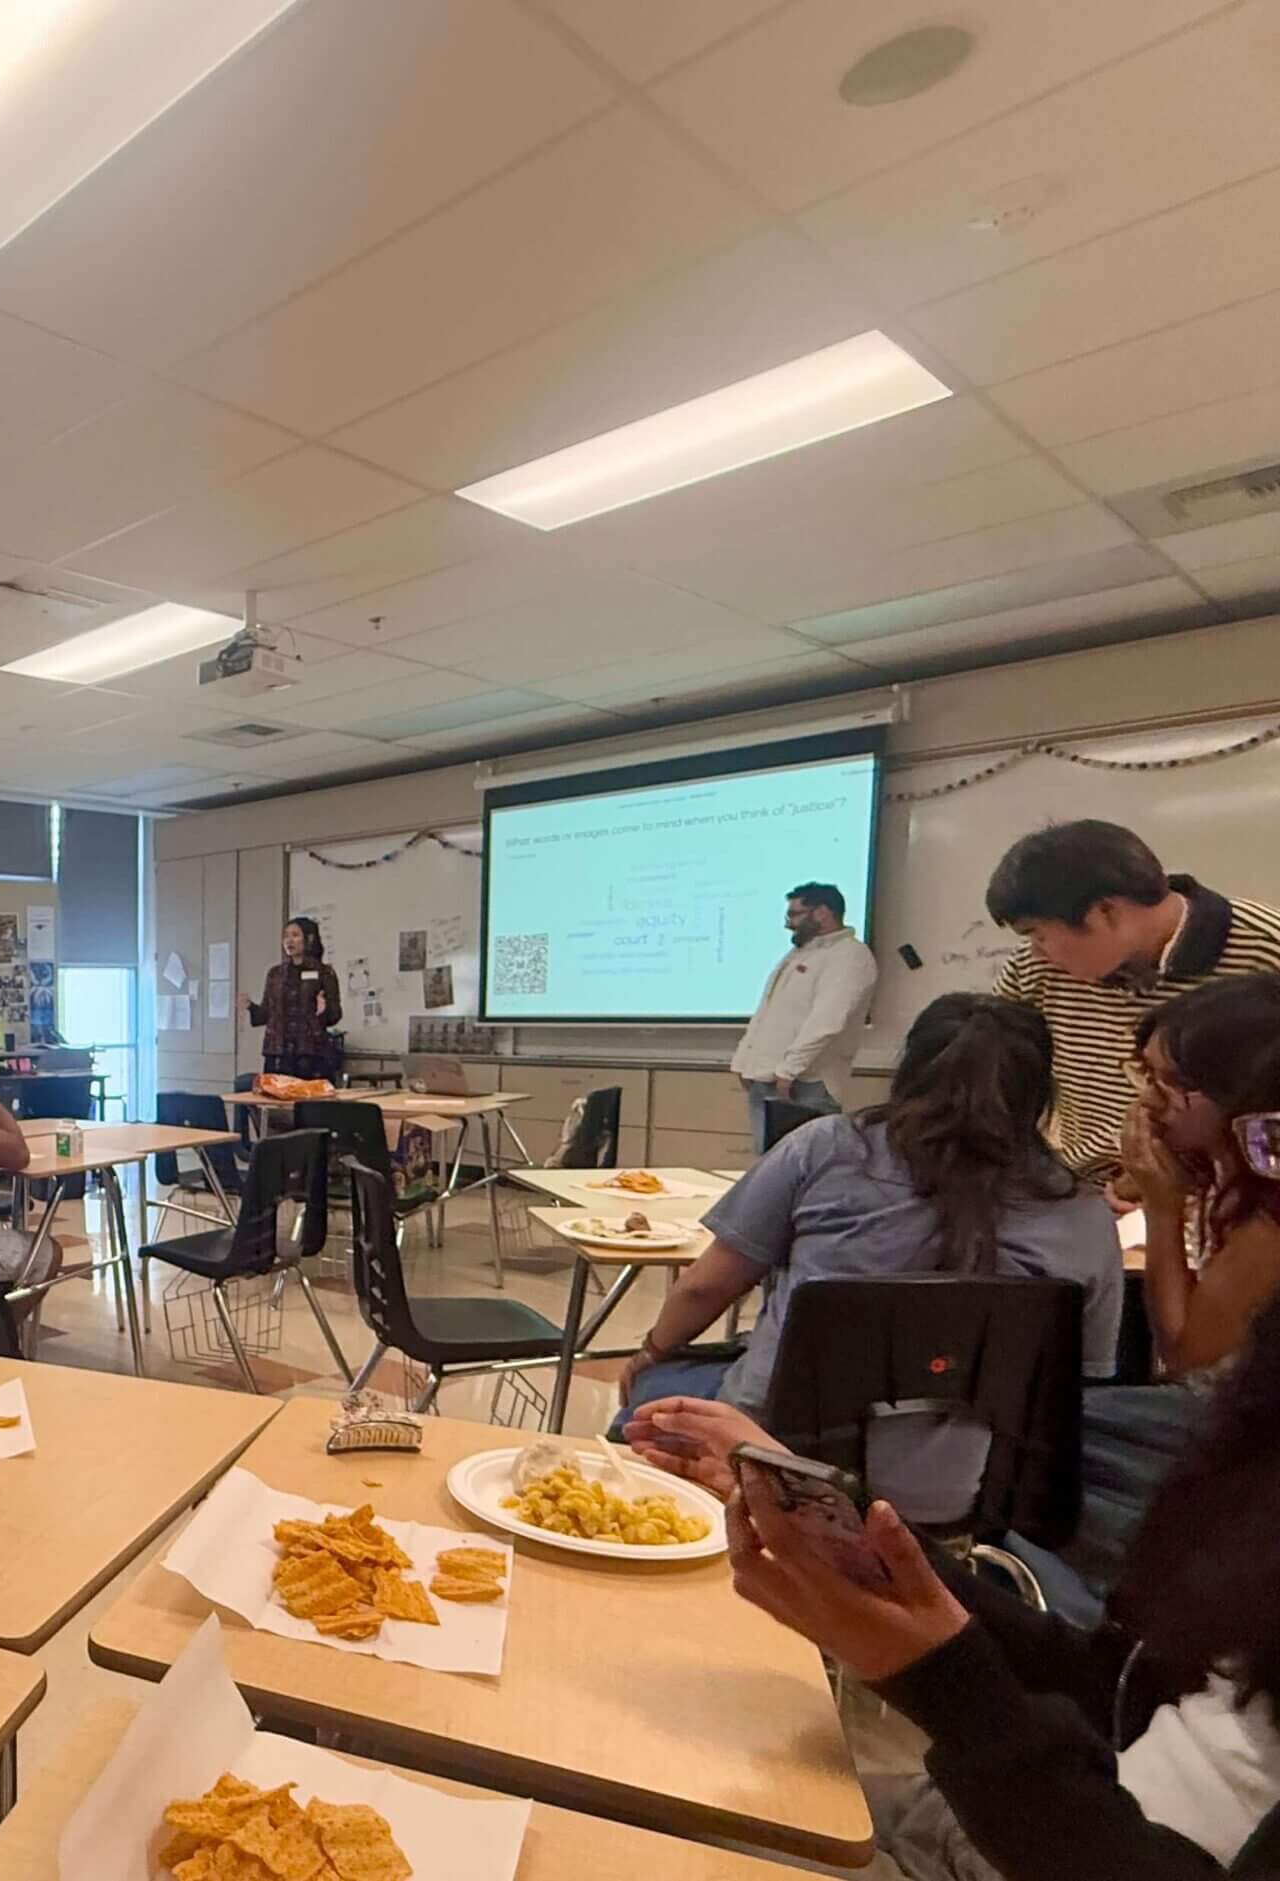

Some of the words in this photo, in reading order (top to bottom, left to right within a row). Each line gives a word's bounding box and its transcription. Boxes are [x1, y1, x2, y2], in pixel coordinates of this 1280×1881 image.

[574, 828, 609, 840] images
[611, 824, 641, 835] come
[655, 818, 682, 829] mind
[684, 815, 714, 827] when
[717, 812, 738, 824] you
[740, 807, 769, 821] think
[772, 803, 786, 816] of
[636, 912, 688, 929] equity
[613, 934, 649, 946] court
